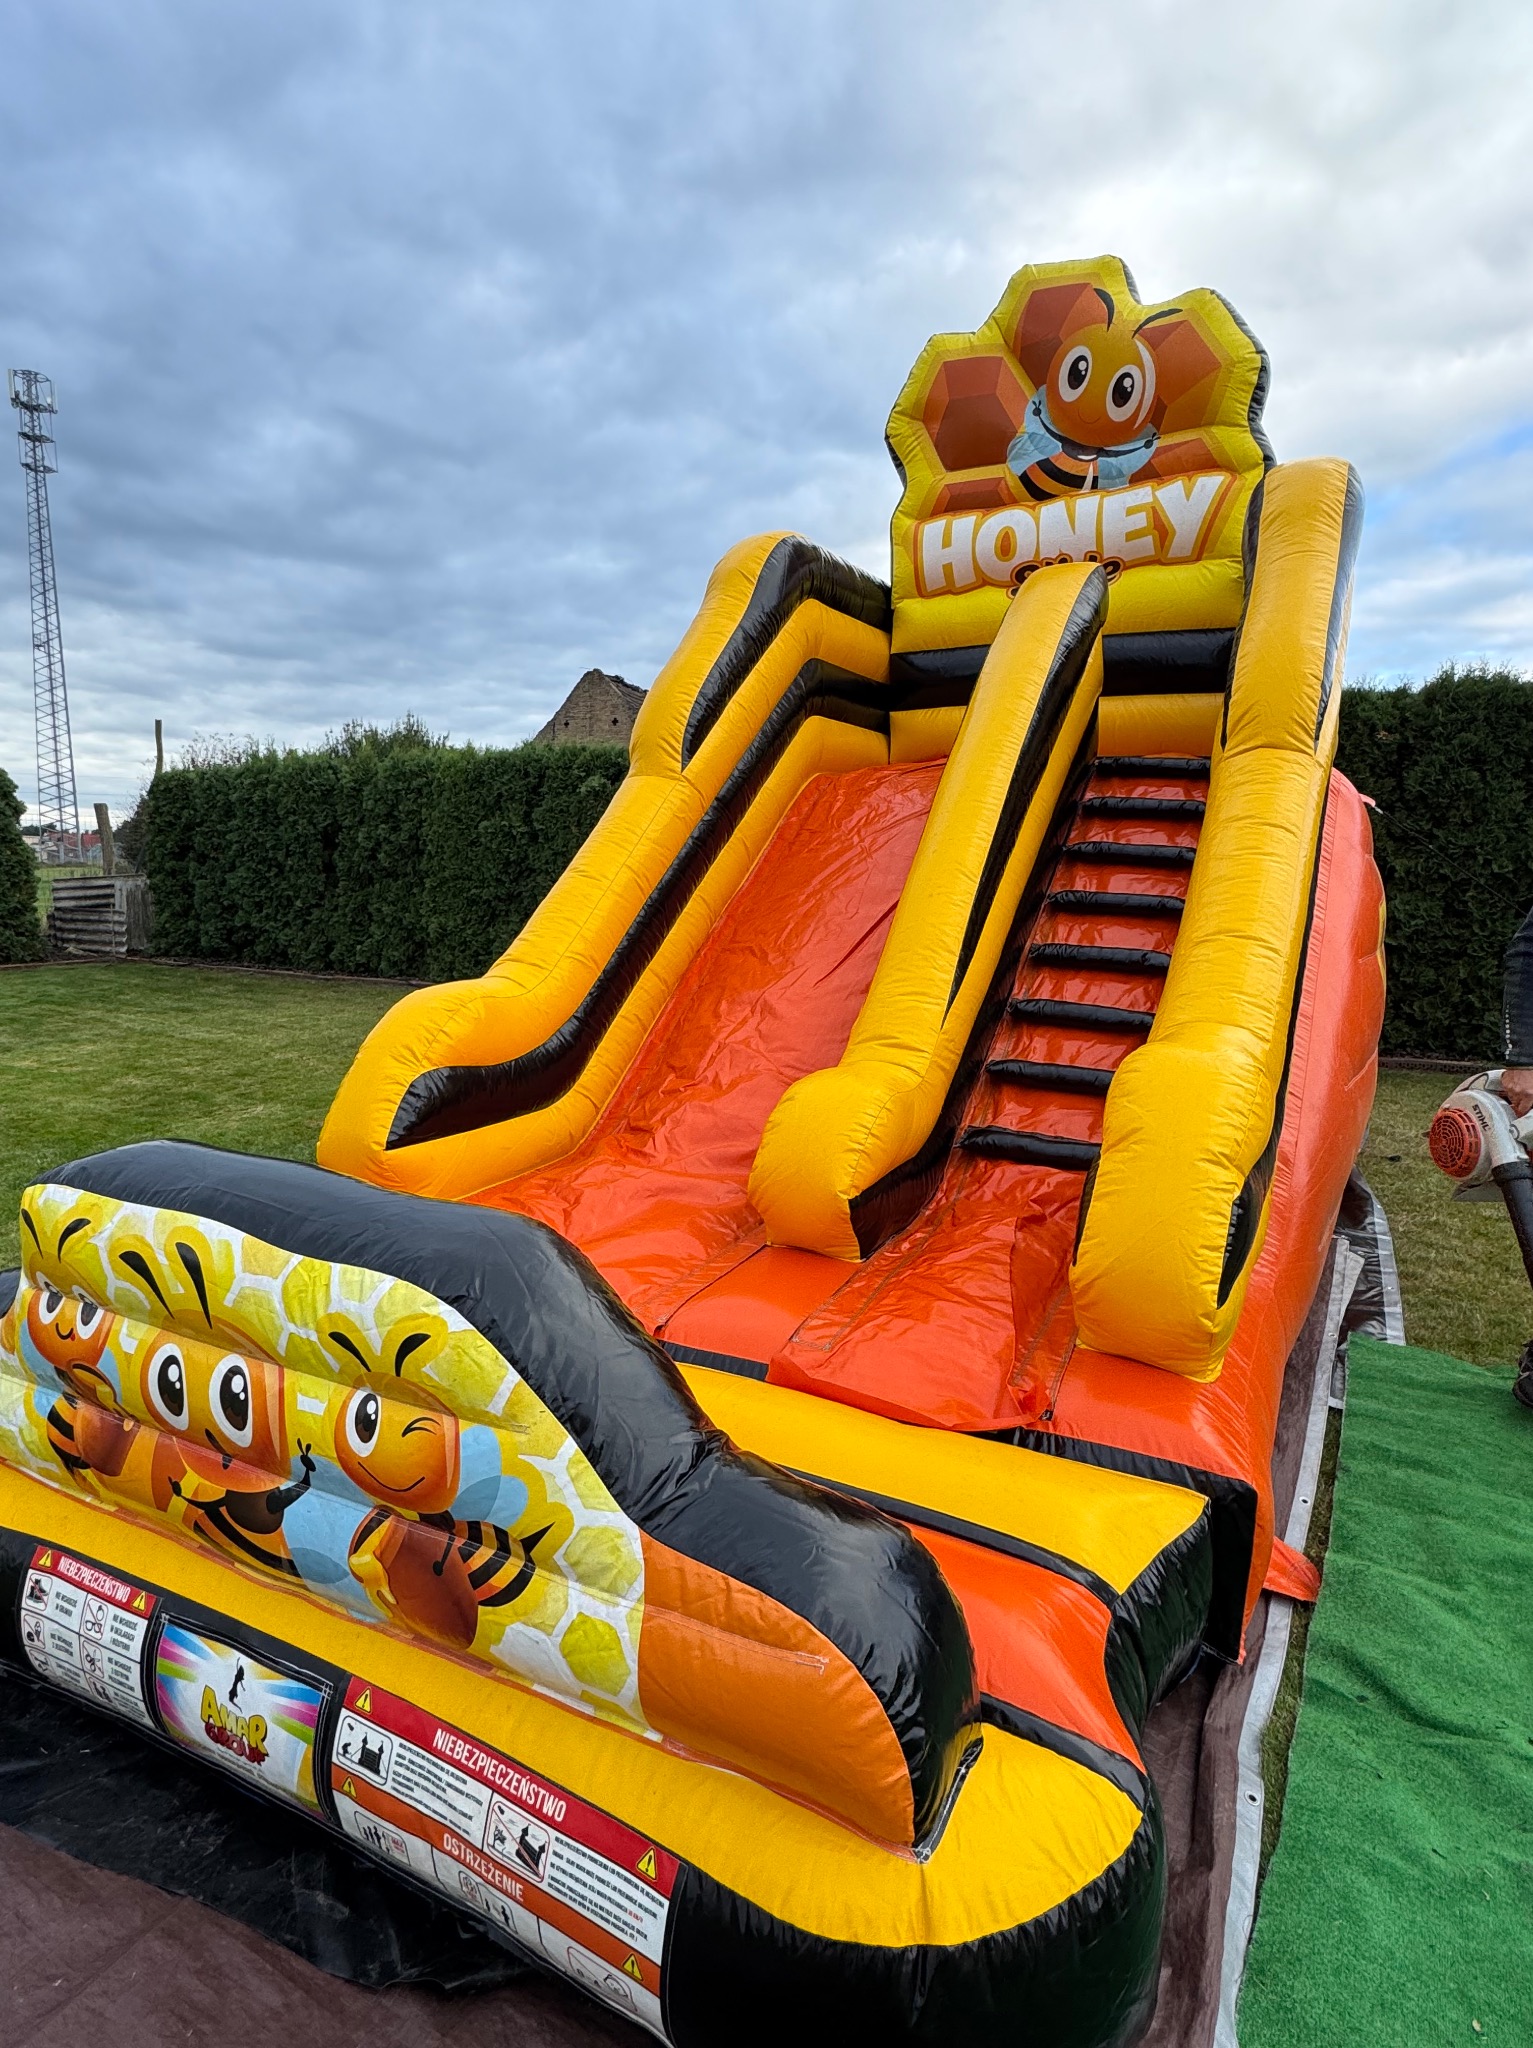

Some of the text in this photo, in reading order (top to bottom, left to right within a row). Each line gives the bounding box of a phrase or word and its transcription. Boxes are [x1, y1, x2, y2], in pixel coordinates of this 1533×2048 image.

[921, 474, 1227, 592] HONEY
[1472, 1104, 1489, 1131] STIHL
[57, 1556, 131, 1603] NIEBEZPIECZEŃSTWO
[201, 1685, 269, 1757] AMAR
[432, 1728, 567, 1822] NIEBEZPIECZEŃSTWO
[443, 1833, 524, 1902] OSTRZEŻENIE
